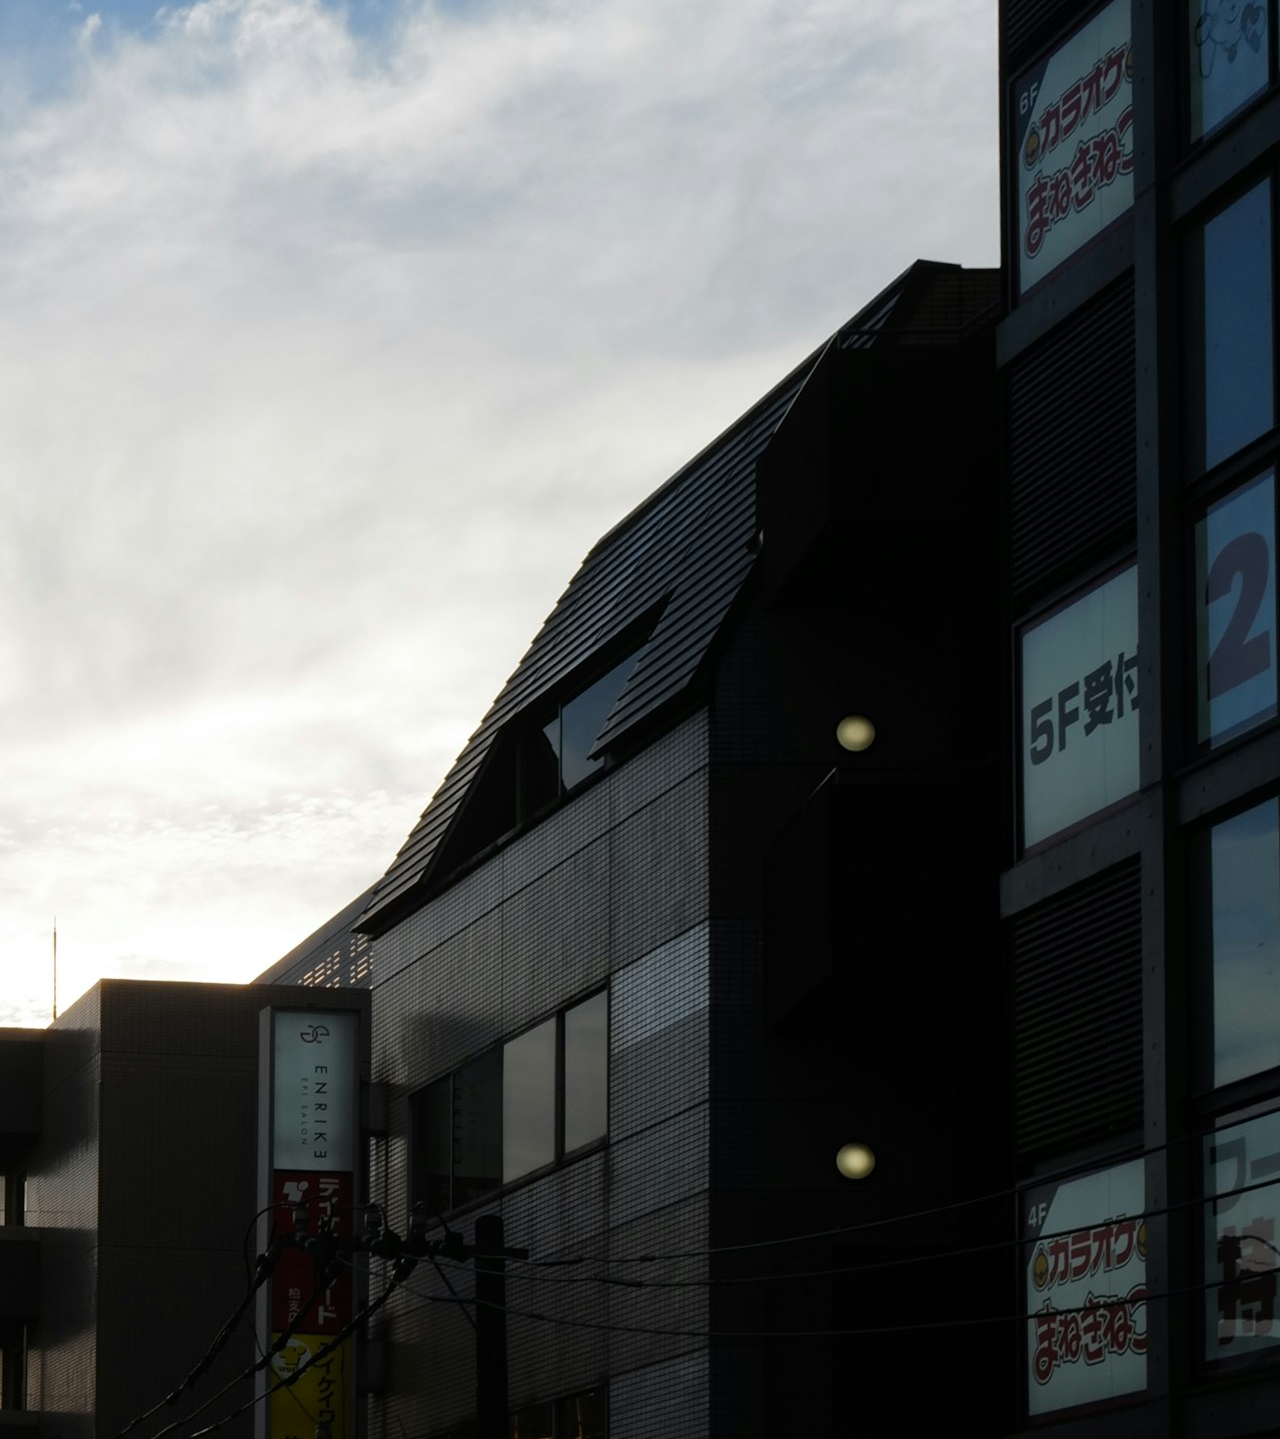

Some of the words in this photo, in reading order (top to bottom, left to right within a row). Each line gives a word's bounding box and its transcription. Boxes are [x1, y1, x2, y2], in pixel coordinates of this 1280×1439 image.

[1019, 81, 1038, 115] 6F
[1039, 45, 1127, 154] カラオケ
[1027, 1202, 1047, 1228] 4F
[1048, 1217, 1138, 1288] カラオケ
